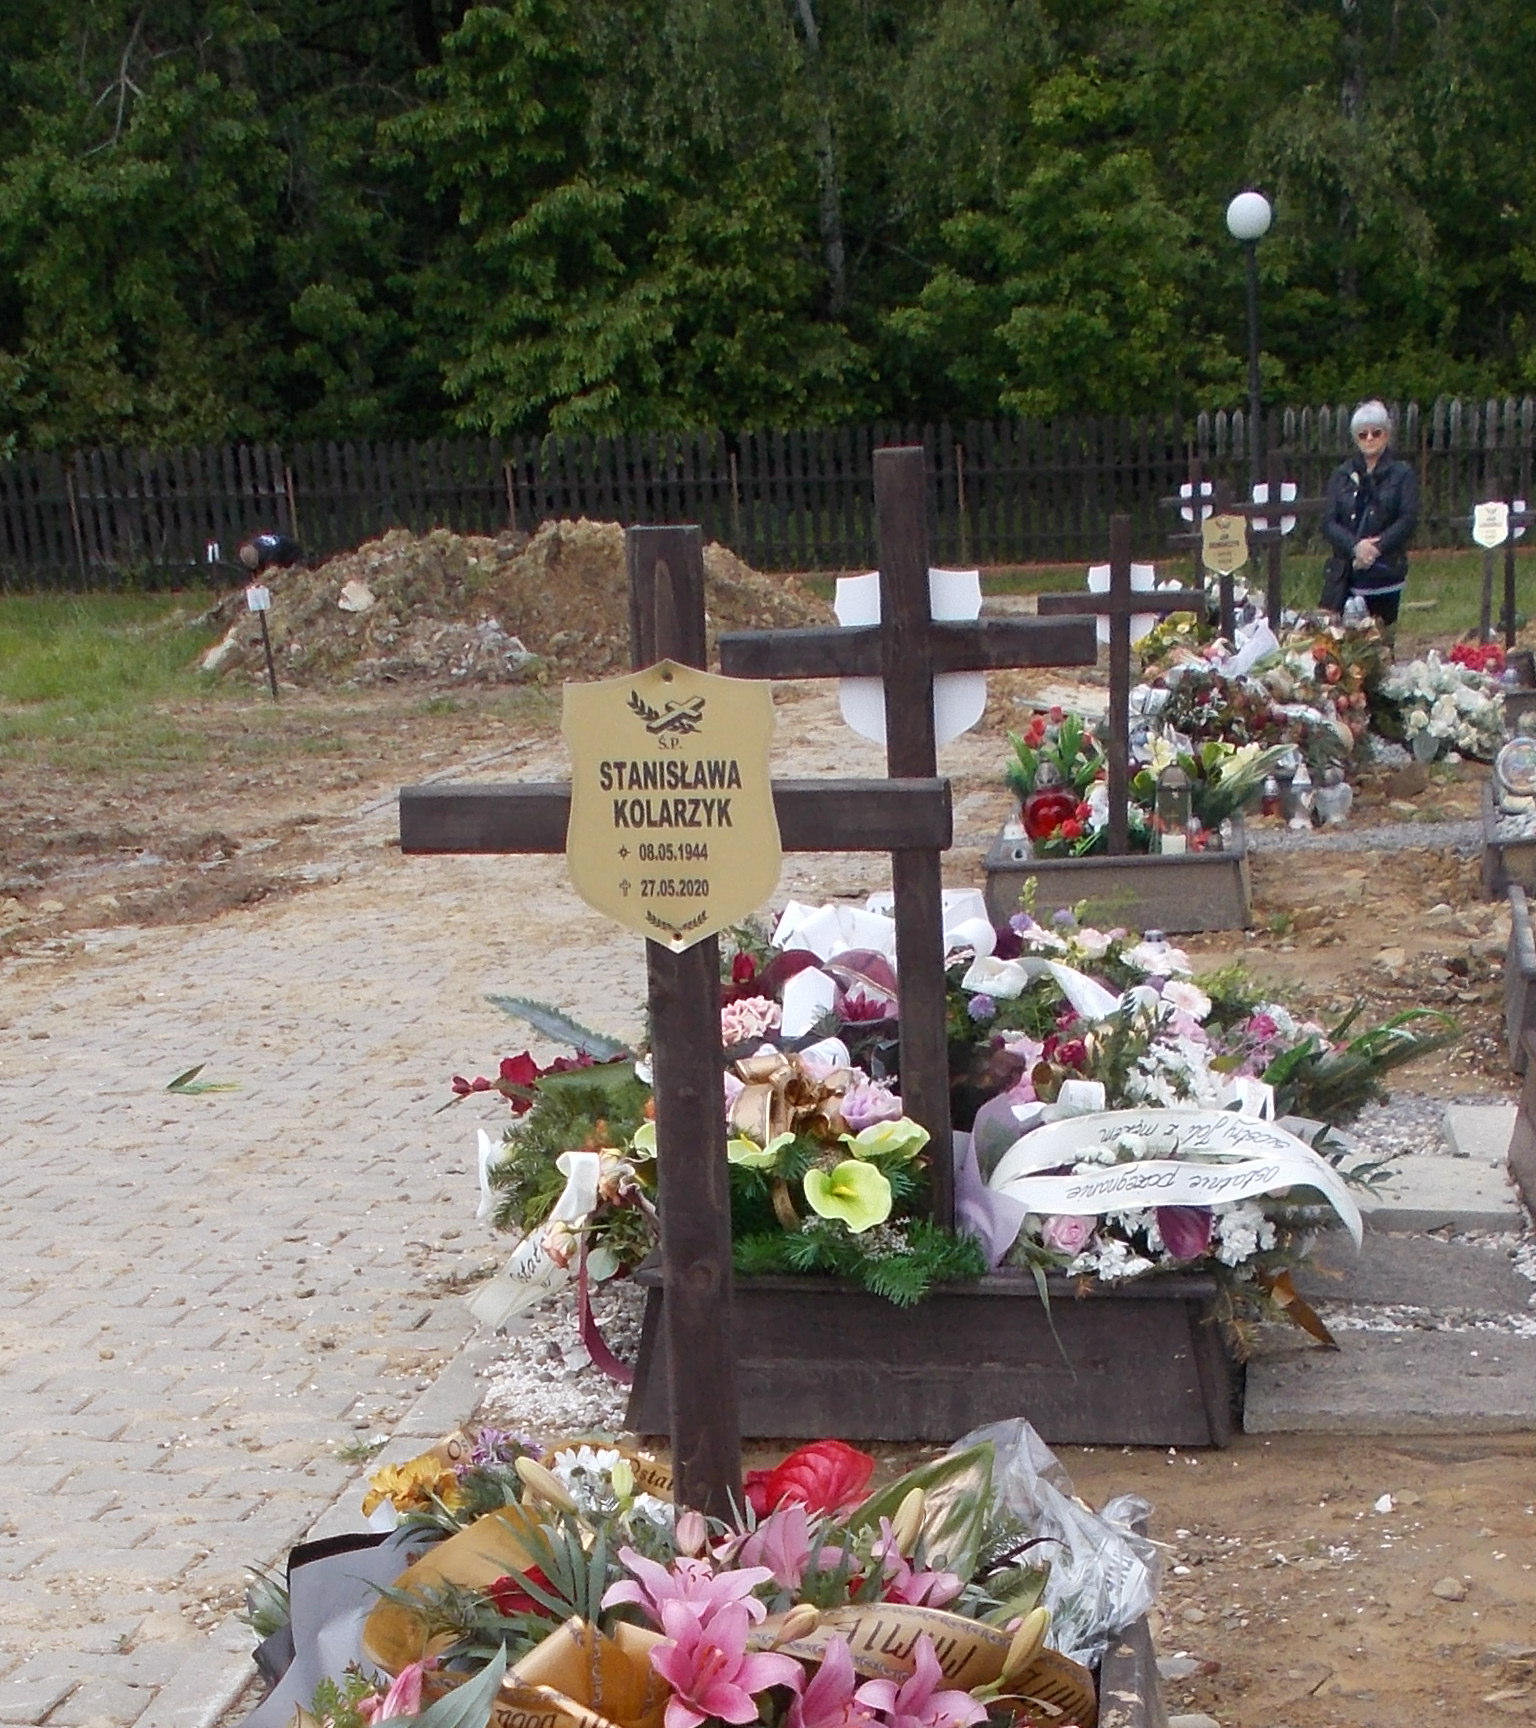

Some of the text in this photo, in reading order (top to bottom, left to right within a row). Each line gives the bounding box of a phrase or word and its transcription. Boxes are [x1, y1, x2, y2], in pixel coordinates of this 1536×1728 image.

[599, 760, 742, 791] STANISŁAWA
[614, 798, 733, 828] KOLARZYK
[638, 843, 708, 861] 08.05.1944
[640, 879, 709, 897] 27.05.2020
